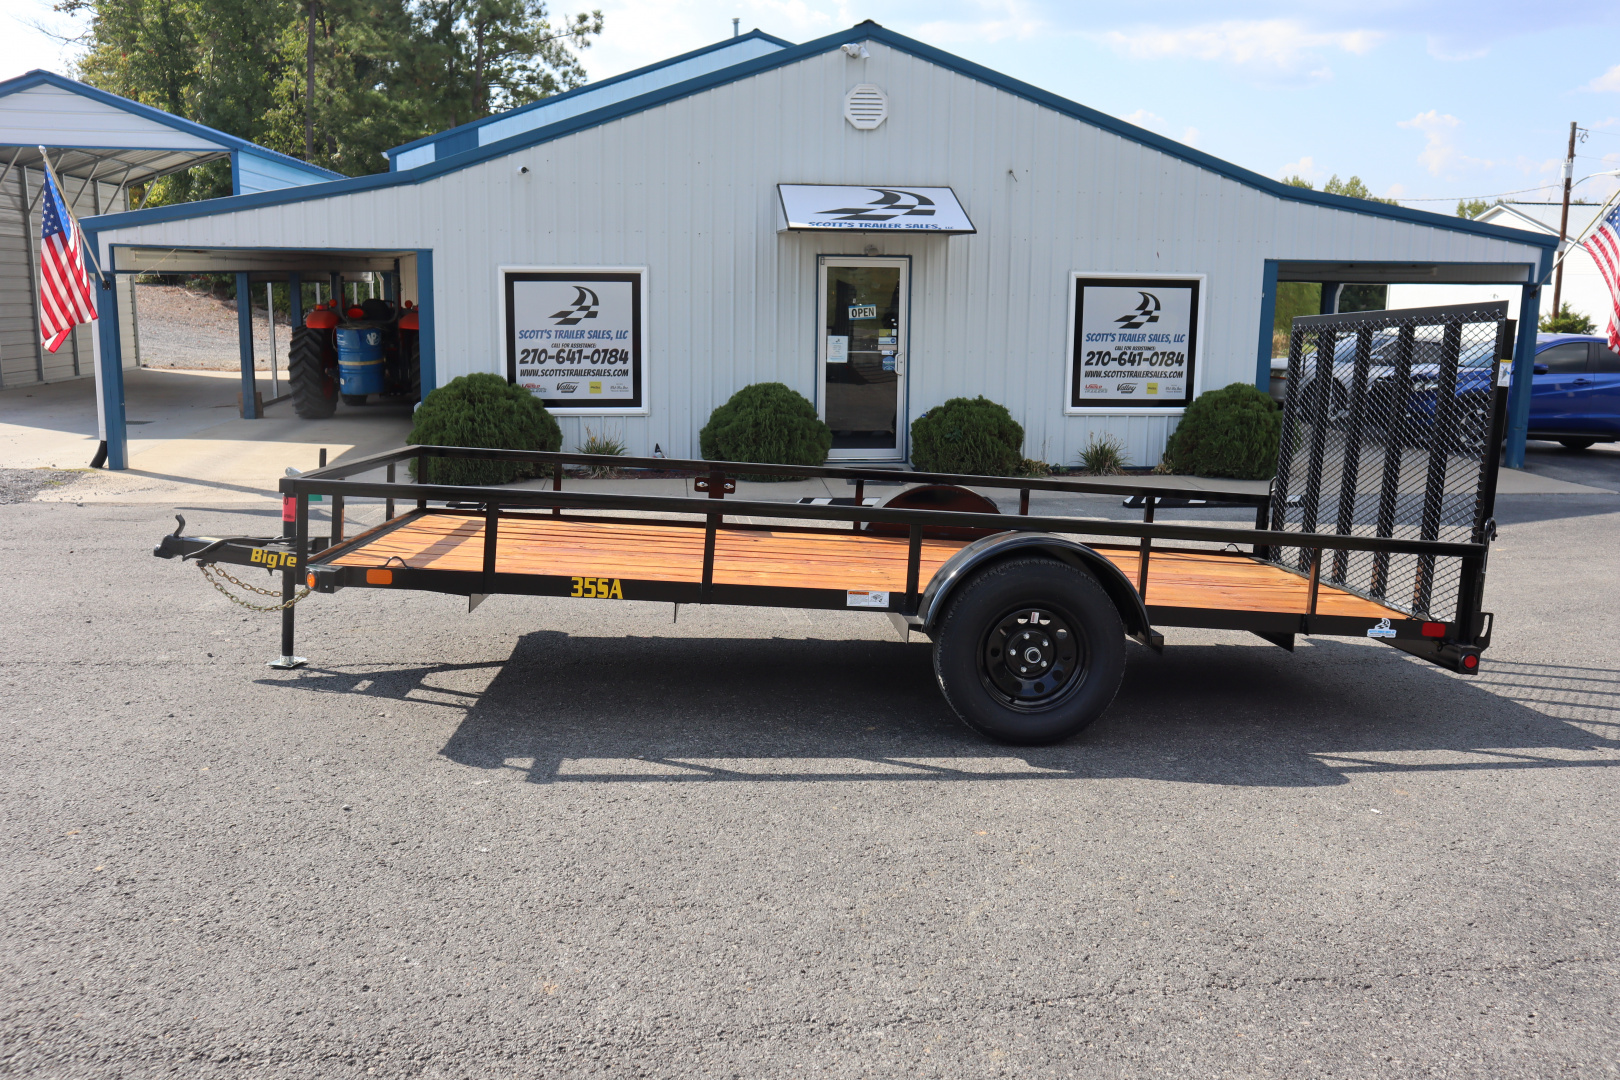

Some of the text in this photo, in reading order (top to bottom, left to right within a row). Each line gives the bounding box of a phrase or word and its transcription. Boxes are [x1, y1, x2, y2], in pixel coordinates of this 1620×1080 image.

[851, 307, 875, 318] OPEN
[519, 329, 629, 341] SCOTT'S TRAILER SALES, LLC
[1085, 332, 1186, 344] SCOTT'S TRAILER SALES, LLC
[519, 348, 629, 365] 270-641-0784
[1084, 351, 1185, 367] 270-641-0784
[520, 369, 629, 378] WWW.SCOTTSTRAILERSALES.COM
[1084, 371, 1183, 379] WWW.SCOTTSTRAILERSALES.COM
[556, 381, 579, 391] Valley
[1116, 382, 1138, 392] Valley
[250, 548, 297, 569] BigTe
[571, 576, 623, 600] 35SA
